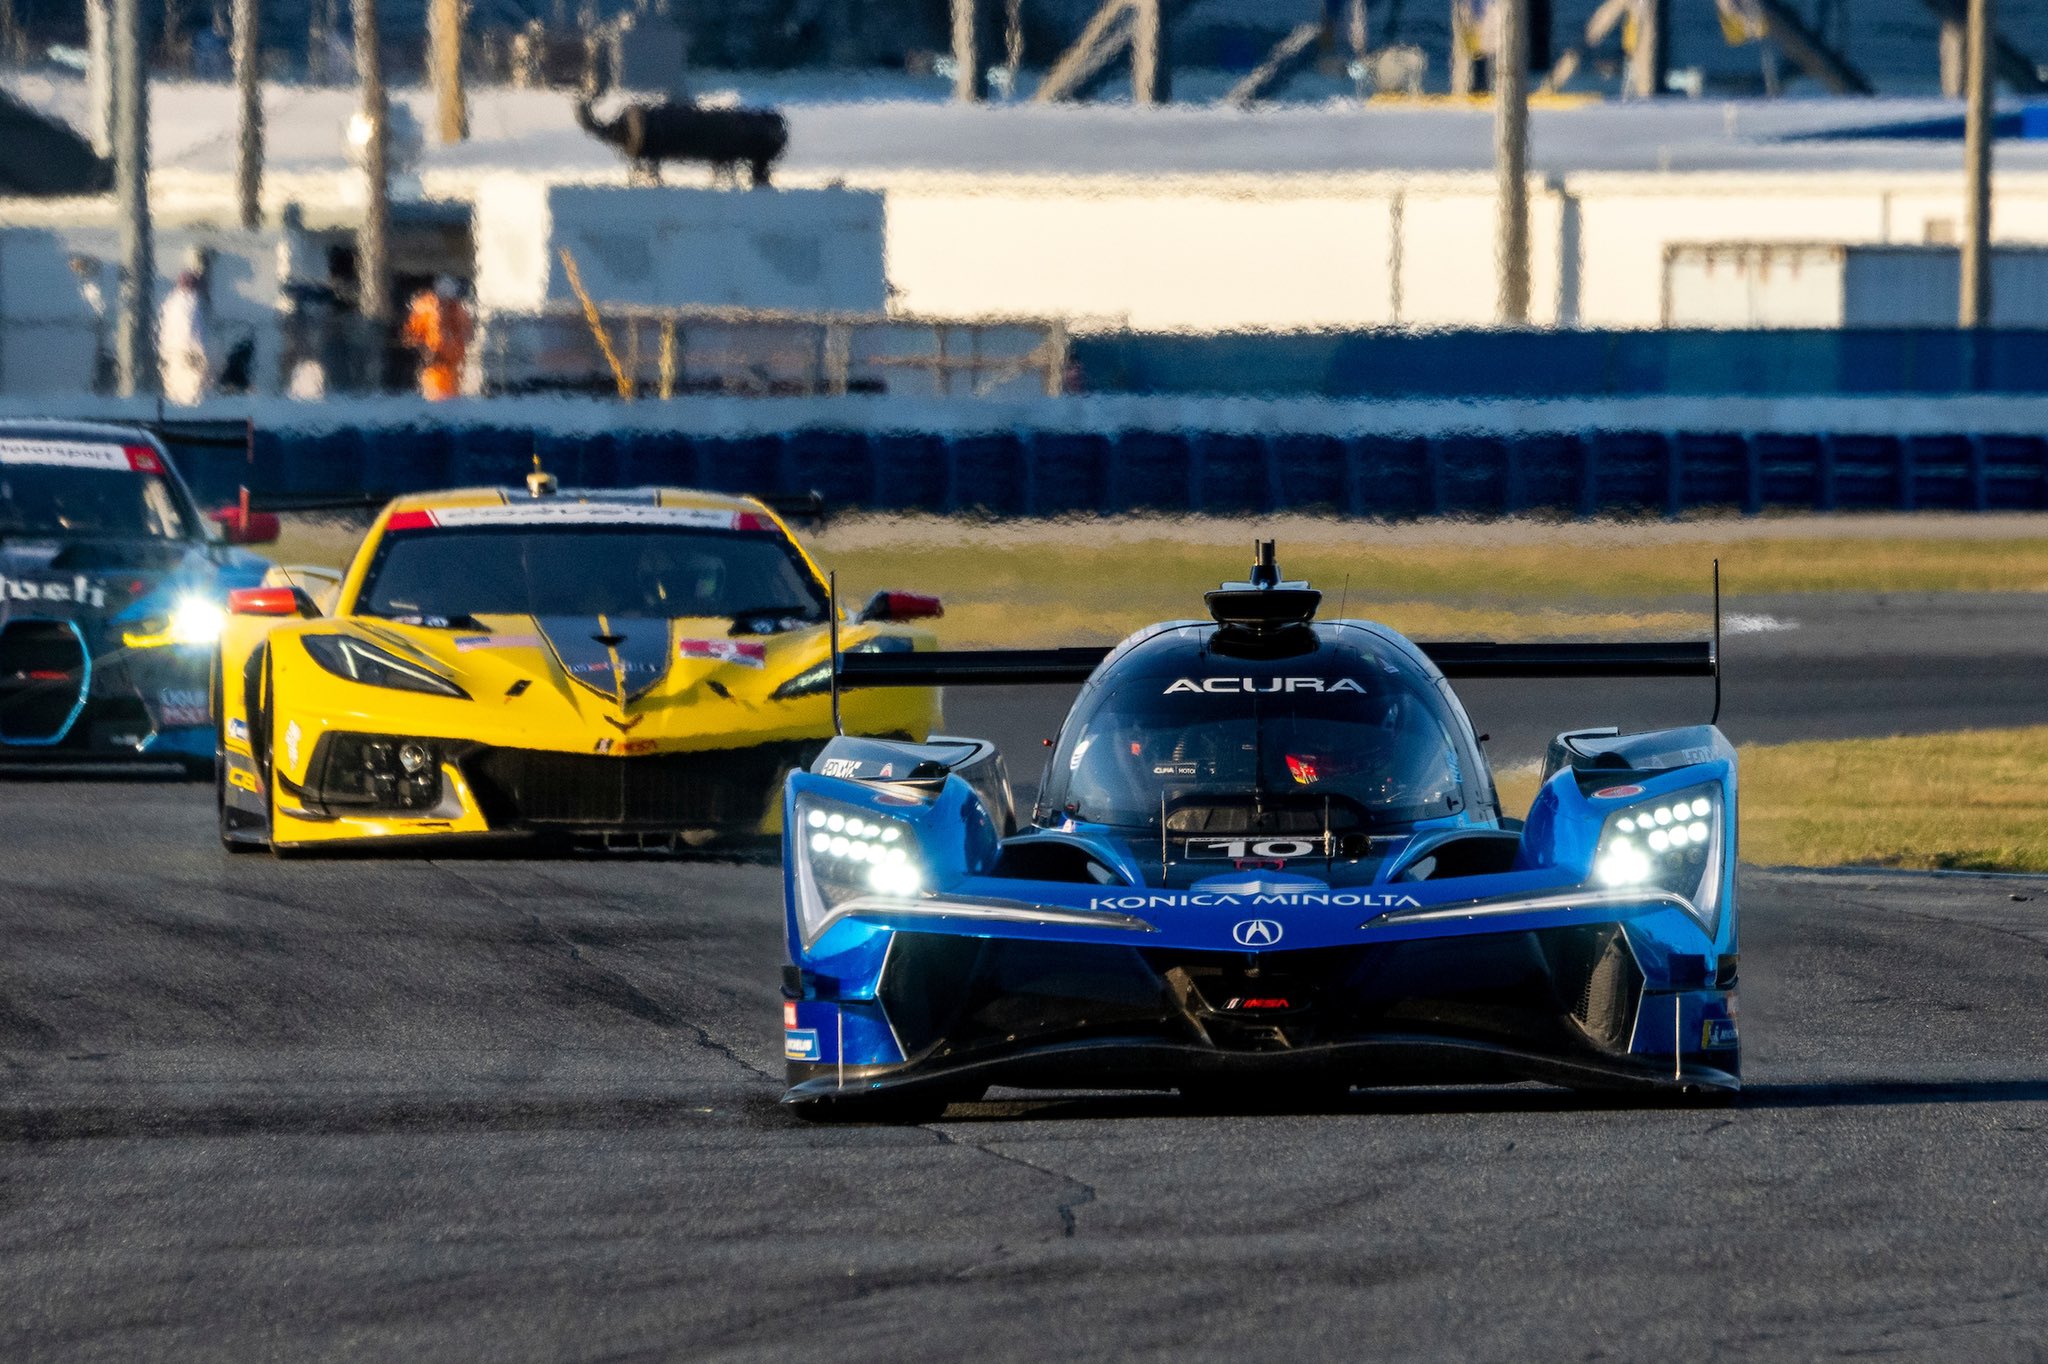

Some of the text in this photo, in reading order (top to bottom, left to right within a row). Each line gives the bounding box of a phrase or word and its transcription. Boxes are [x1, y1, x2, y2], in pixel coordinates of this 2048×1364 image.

[1163, 677, 1367, 694] ACURA
[1207, 841, 1314, 858] 10
[1090, 893, 1422, 910] KONICA MINOLTA
